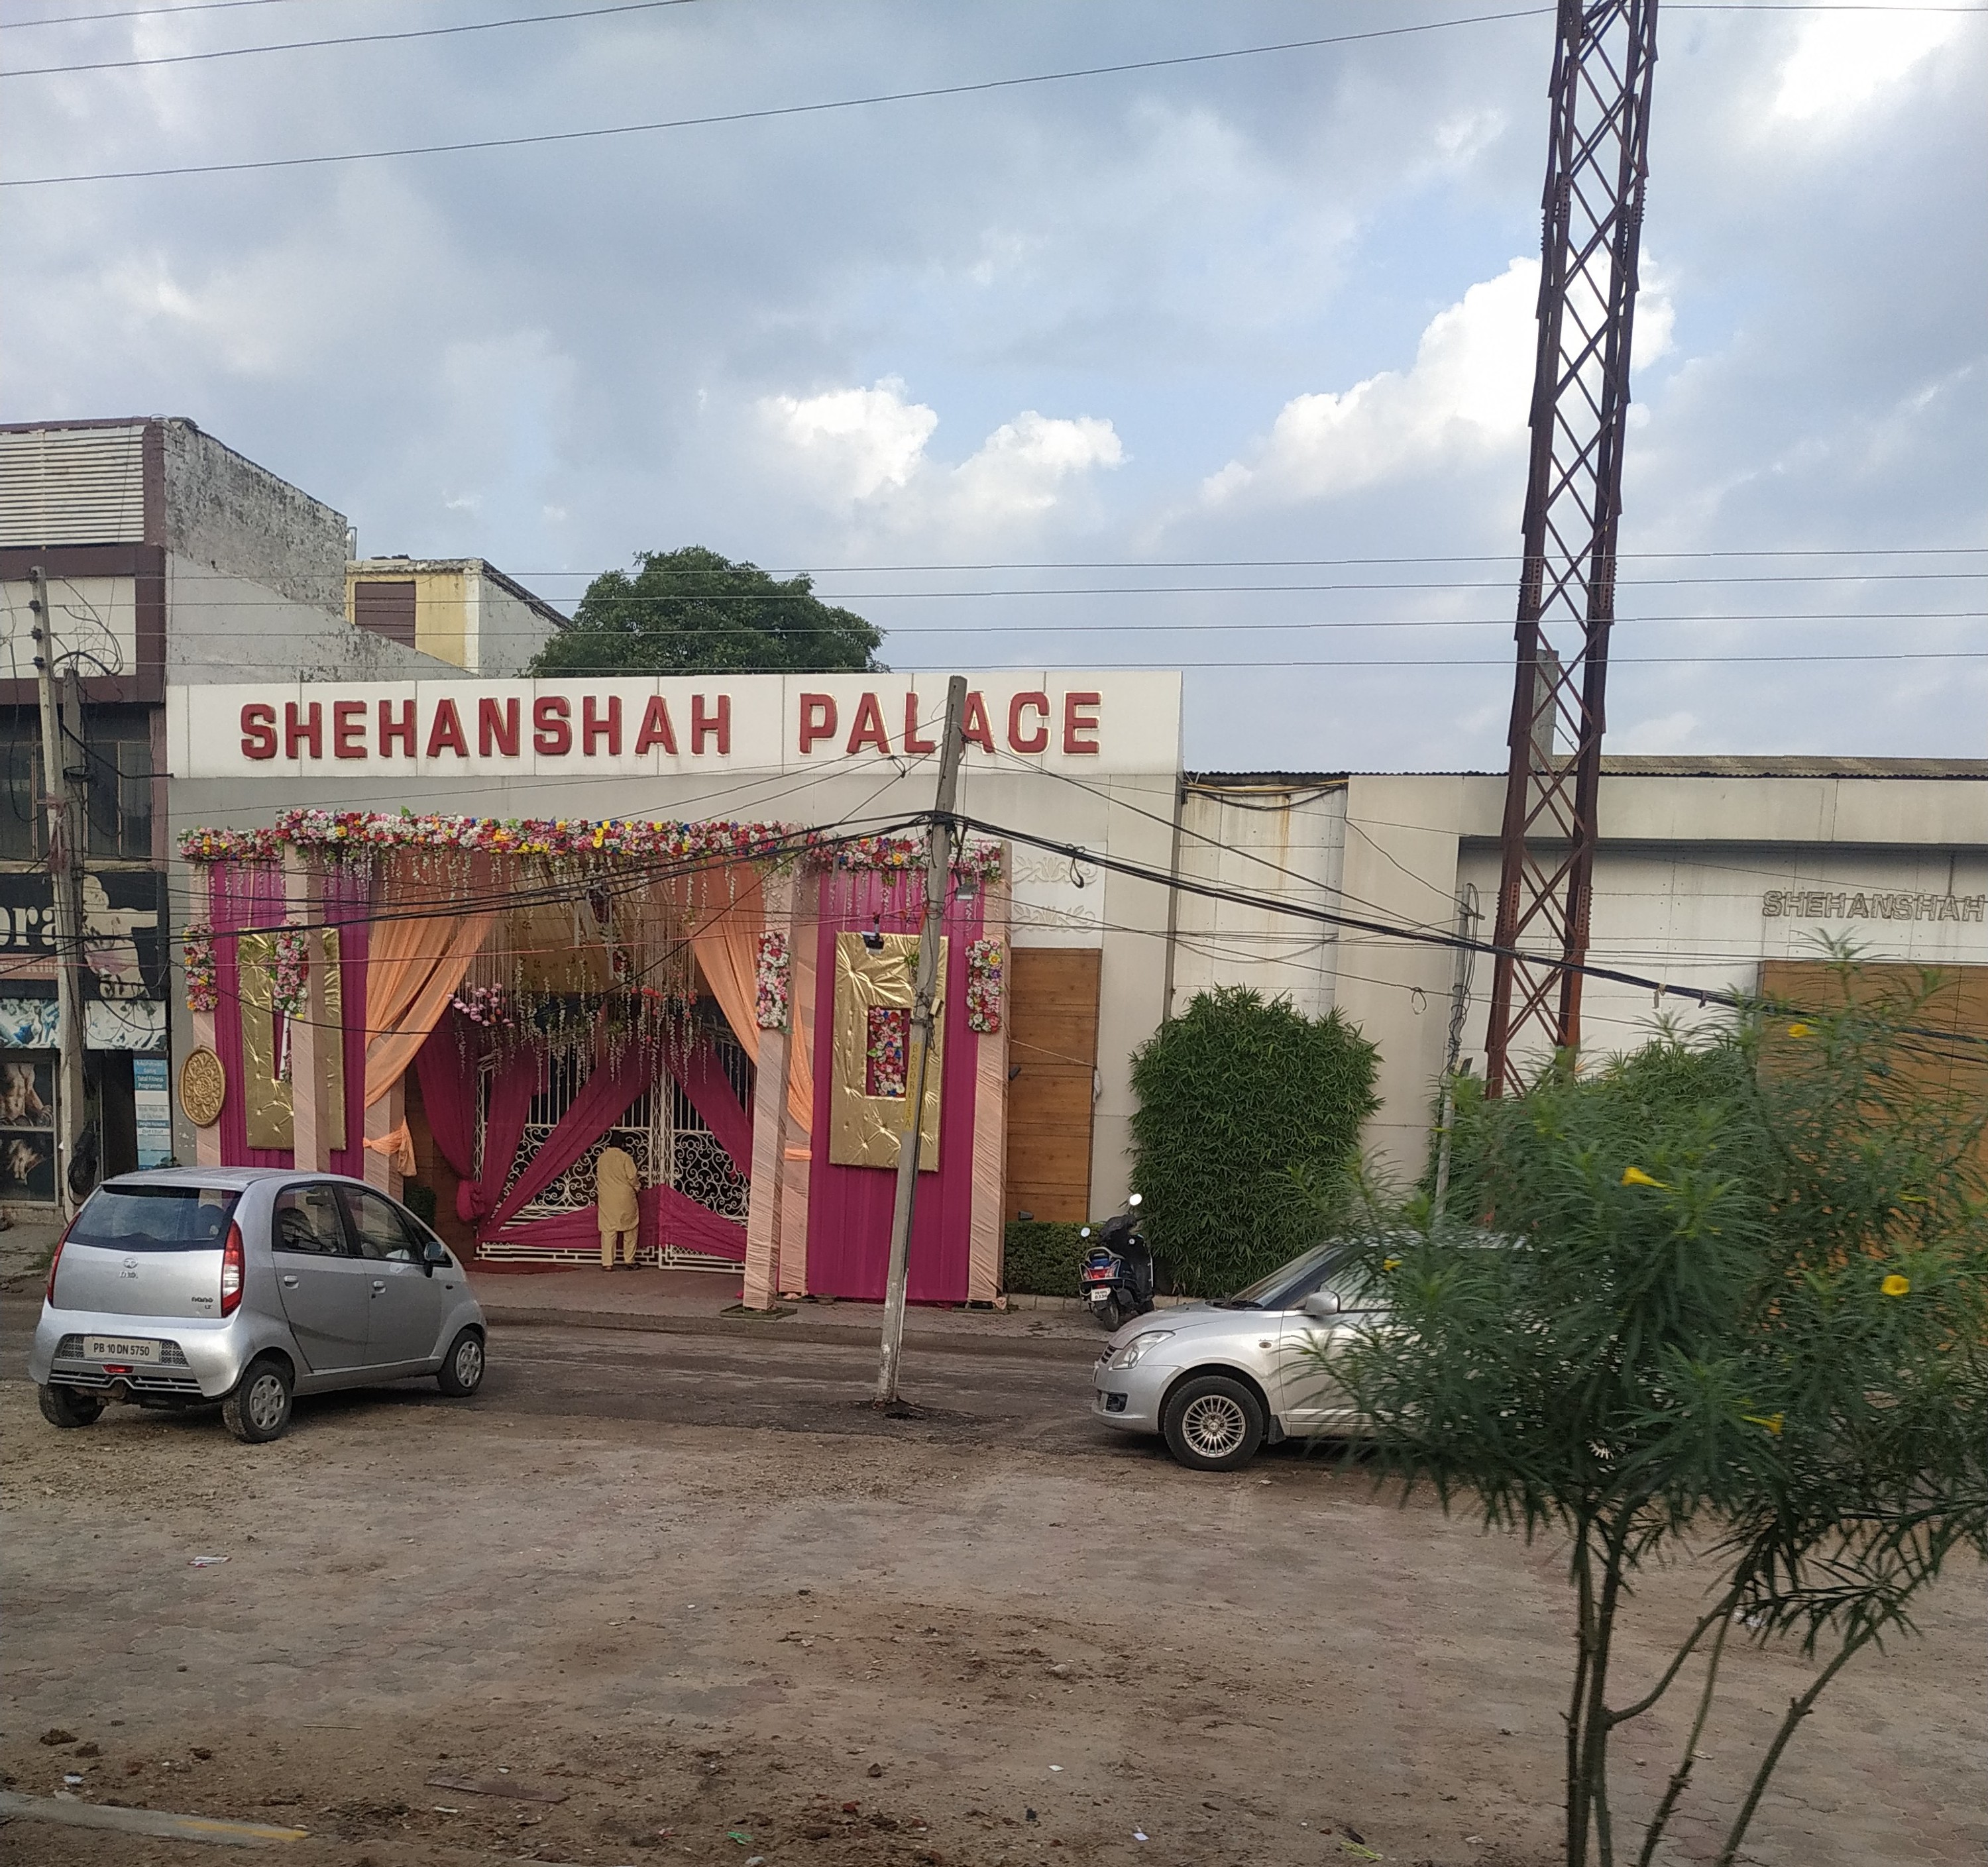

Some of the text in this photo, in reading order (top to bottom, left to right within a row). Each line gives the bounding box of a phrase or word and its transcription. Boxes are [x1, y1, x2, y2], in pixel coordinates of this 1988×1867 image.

[241, 691, 1103, 760] SHEHANSHAH PALACE
[1761, 890, 1986, 922] SHEHANSHAH
[93, 1342, 150, 1356] PB 10 DN 5750
